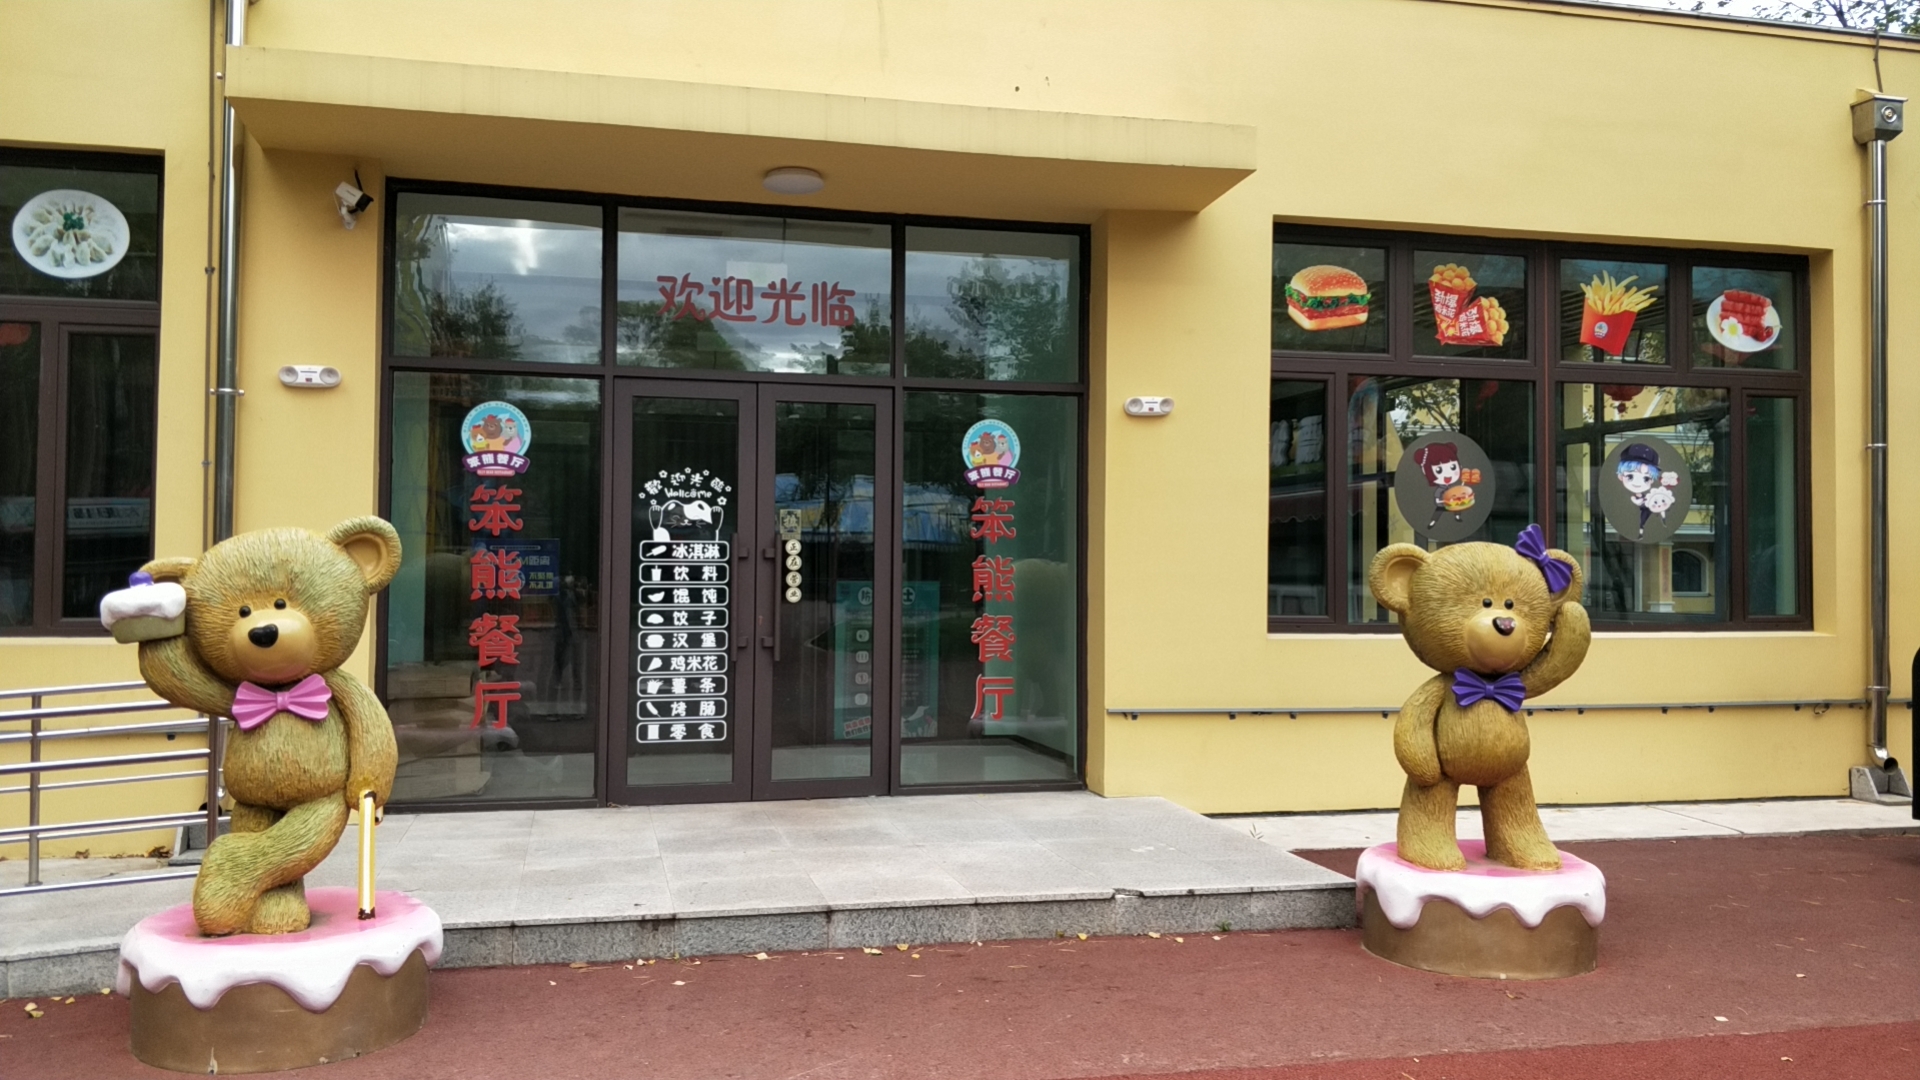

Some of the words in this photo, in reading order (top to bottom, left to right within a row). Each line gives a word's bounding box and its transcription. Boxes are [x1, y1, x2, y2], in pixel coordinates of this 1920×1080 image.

[656, 272, 856, 327] 欢迎光临
[672, 543, 720, 559] 冰淇淋
[673, 565, 718, 581] 饮料
[788, 541, 800, 599] 正在营业
[672, 588, 717, 604] 馄饨
[468, 484, 524, 729] 笨熊餐厅
[970, 496, 1017, 720] 笨熊餐厅
[672, 610, 717, 626] 饺子
[672, 632, 717, 648] 汉堡
[670, 655, 718, 671] 鸡米花
[670, 677, 716, 694] 薯条
[670, 700, 716, 717] 烤肠
[669, 722, 715, 740] 零食
